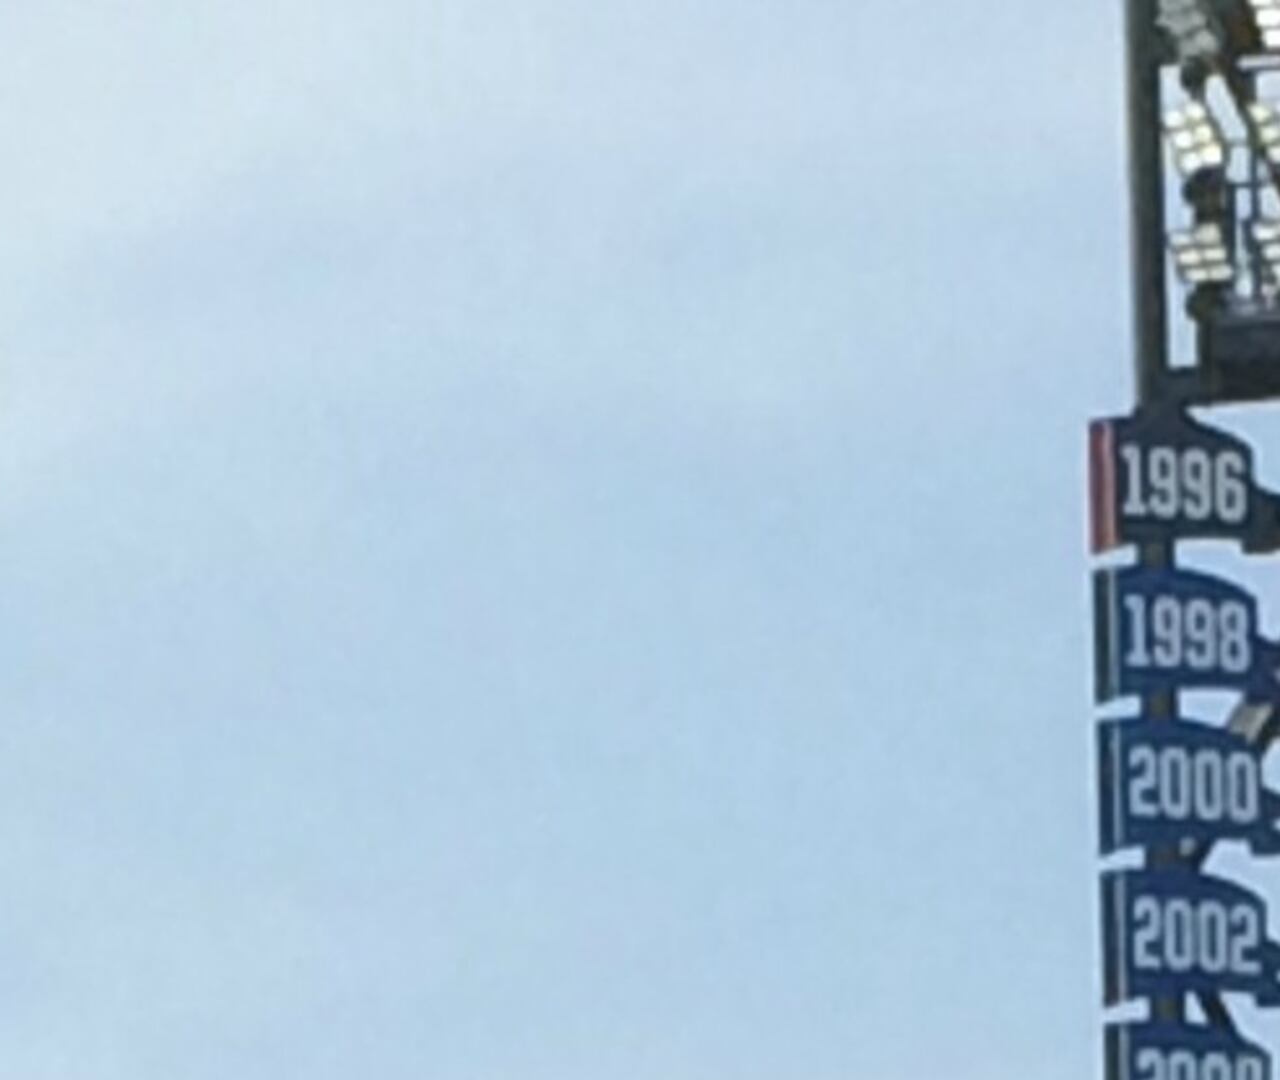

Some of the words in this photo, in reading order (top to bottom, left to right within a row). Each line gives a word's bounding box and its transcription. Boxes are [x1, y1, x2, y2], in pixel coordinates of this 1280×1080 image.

[1121, 445, 1247, 522] 1996
[1125, 596, 1251, 671] 1998
[1129, 747, 1259, 822] 2000
[1133, 899, 1261, 973] 2002
